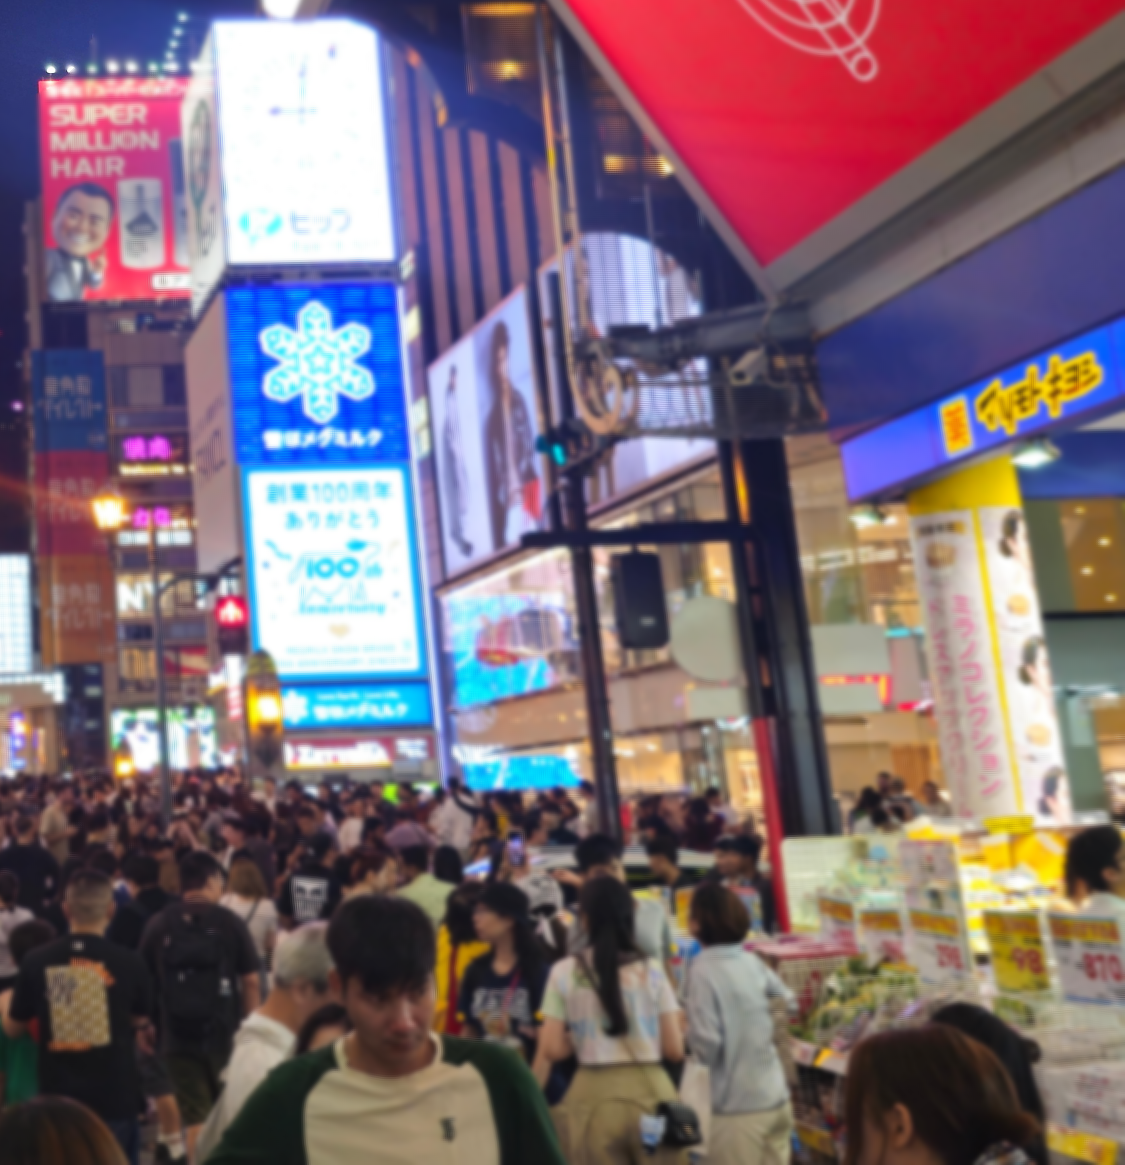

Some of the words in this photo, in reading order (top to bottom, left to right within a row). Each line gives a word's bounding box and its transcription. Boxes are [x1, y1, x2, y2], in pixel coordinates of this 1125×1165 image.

[49, 103, 148, 127] SUPER
[50, 130, 161, 152] MILLION
[51, 157, 125, 178] HAIR
